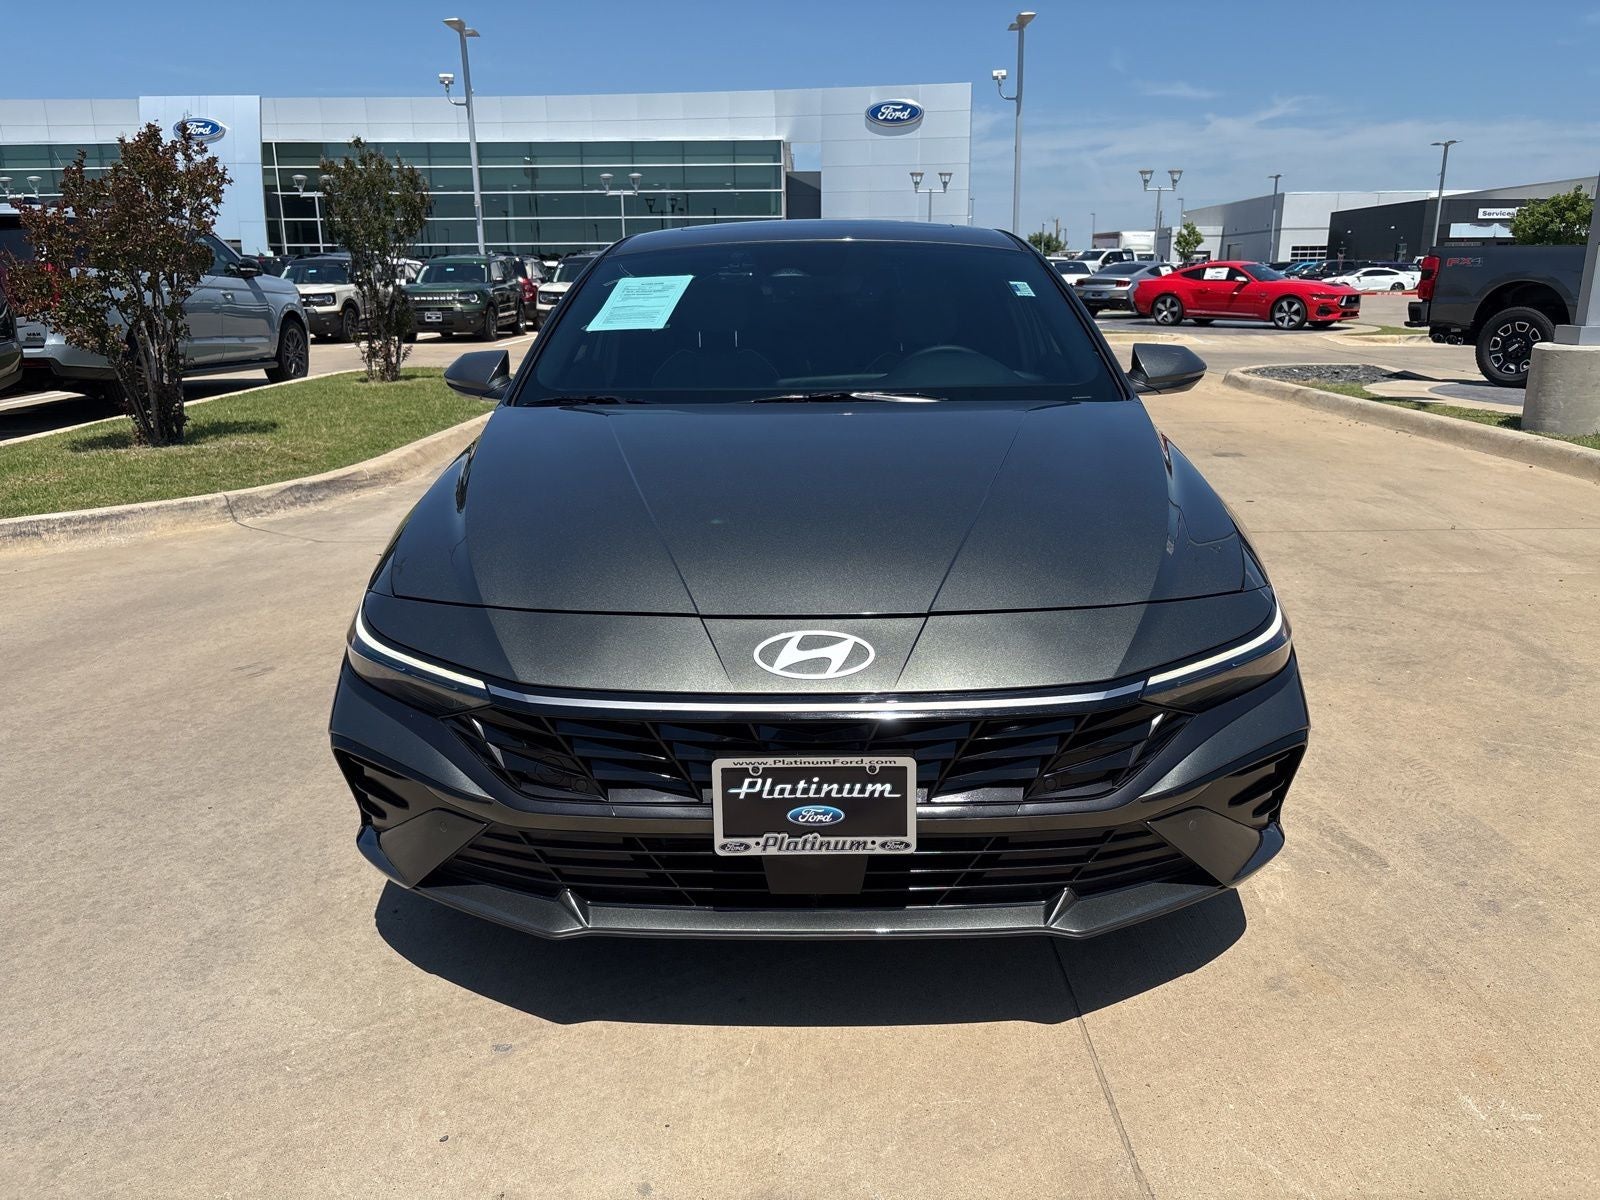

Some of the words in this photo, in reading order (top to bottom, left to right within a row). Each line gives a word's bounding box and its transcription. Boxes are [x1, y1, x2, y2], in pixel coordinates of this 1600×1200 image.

[878, 104, 911, 120] Ford
[186, 121, 213, 135] Ford
[1446, 257, 1482, 268] FX4
[732, 758, 897, 767] www.PlatinumFord.com
[727, 776, 902, 799] Platinum
[798, 808, 833, 822] Ford
[724, 842, 746, 852] Ford
[761, 835, 876, 852] Platinum
[886, 841, 906, 851] Ford
